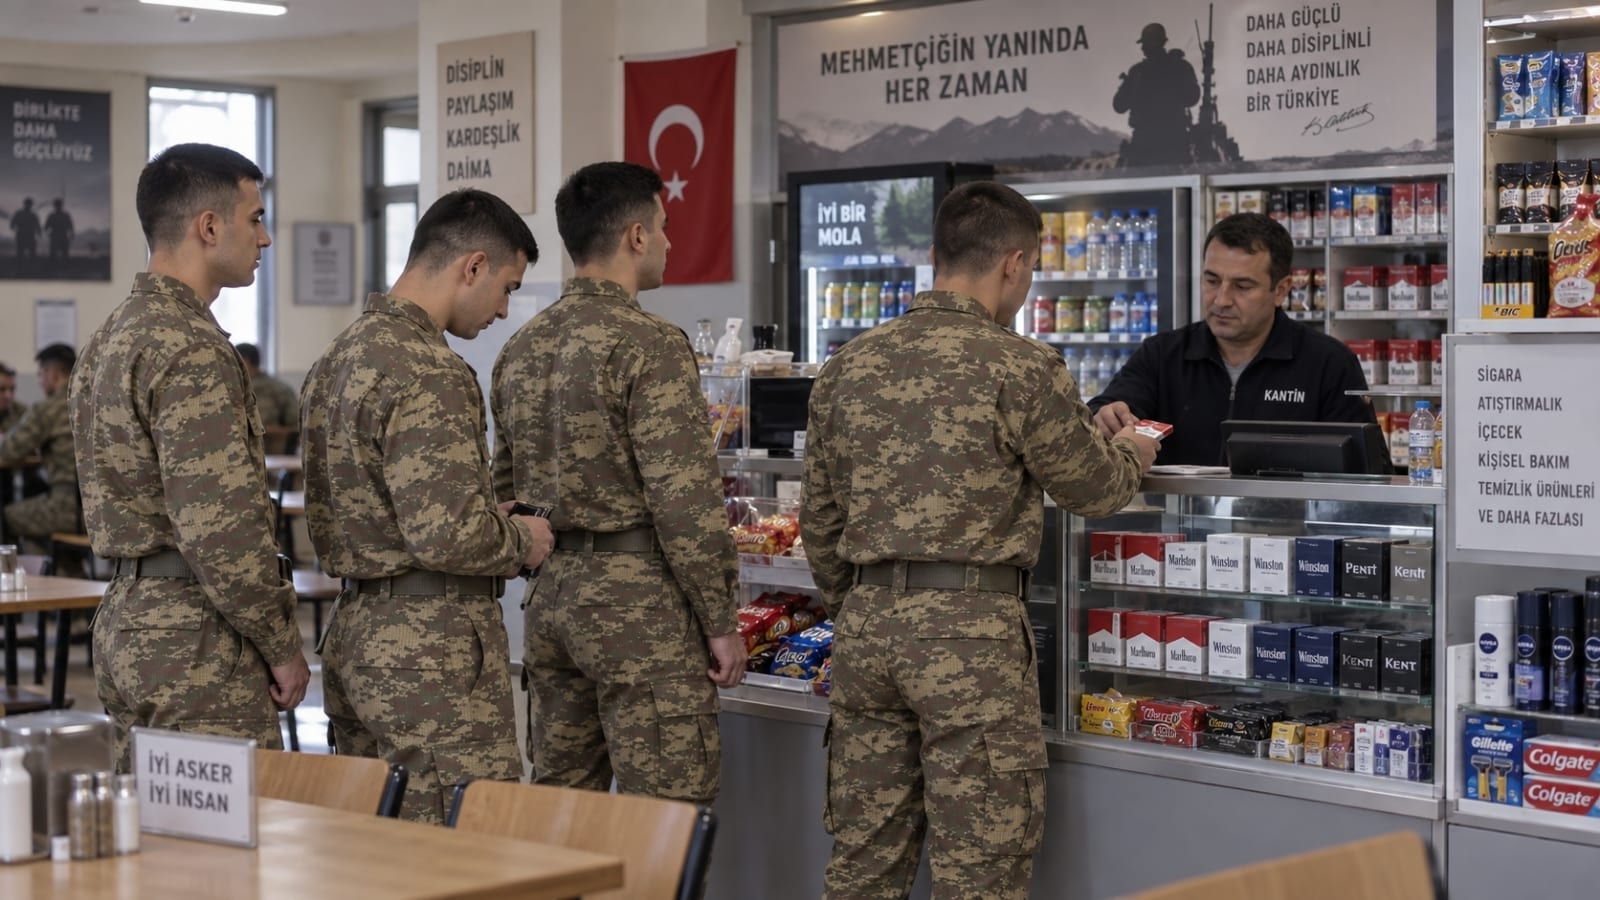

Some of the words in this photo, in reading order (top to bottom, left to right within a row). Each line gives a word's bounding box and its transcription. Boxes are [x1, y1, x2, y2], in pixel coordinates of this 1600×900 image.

[1247, 12, 1286, 32] DAHA
[1292, 3, 1341, 29] GÜÇLÜ
[820, 33, 975, 76] MEHMETÇİĞİN
[984, 25, 1089, 59] YANINDA
[1247, 39, 1286, 58] DAHA
[1292, 26, 1371, 54] DİSİPLİNLİ
[446, 55, 504, 84] DİSİPLİN
[1247, 66, 1286, 85] DAHA
[1291, 59, 1360, 82] AYDINLIK
[886, 78, 930, 104] HER
[939, 68, 1028, 99] ZAMAN
[446, 90, 514, 117] PAYLAŞIM
[1247, 92, 1271, 112] BİR
[1276, 86, 1340, 110] TÜRKİYE
[446, 119, 521, 149] KARDEŞLİK
[447, 157, 492, 181] DAİMA
[817, 201, 837, 224] İYİ
[840, 200, 866, 223] BİR
[818, 227, 862, 246] MOLA
[1477, 365, 1523, 382] SİGARA
[1264, 388, 1306, 403] KANTİN
[1477, 396, 1563, 413] ATIŞTIRMALIK
[1478, 422, 1523, 441] İÇECEK
[1478, 450, 1525, 470] KİŞİSEL
[1530, 454, 1570, 469] BAKIM
[1478, 479, 1533, 497] TEMİZLİK
[1537, 480, 1595, 499] ÜRÜNLERİ
[1478, 509, 1493, 523] VE
[1498, 510, 1530, 525] DAHA
[1535, 511, 1583, 527] FAZLASI
[1210, 555, 1239, 569] Winston
[1213, 640, 1242, 655] Winston
[1385, 657, 1417, 672] KENT
[1471, 736, 1514, 752] Gillette
[149, 750, 170, 775] İYİ
[176, 759, 233, 784] ASKER
[1529, 748, 1595, 771] Colgate
[149, 780, 170, 804] İYİ
[177, 783, 229, 813] İNSAN
[1528, 784, 1592, 807] Colgate
